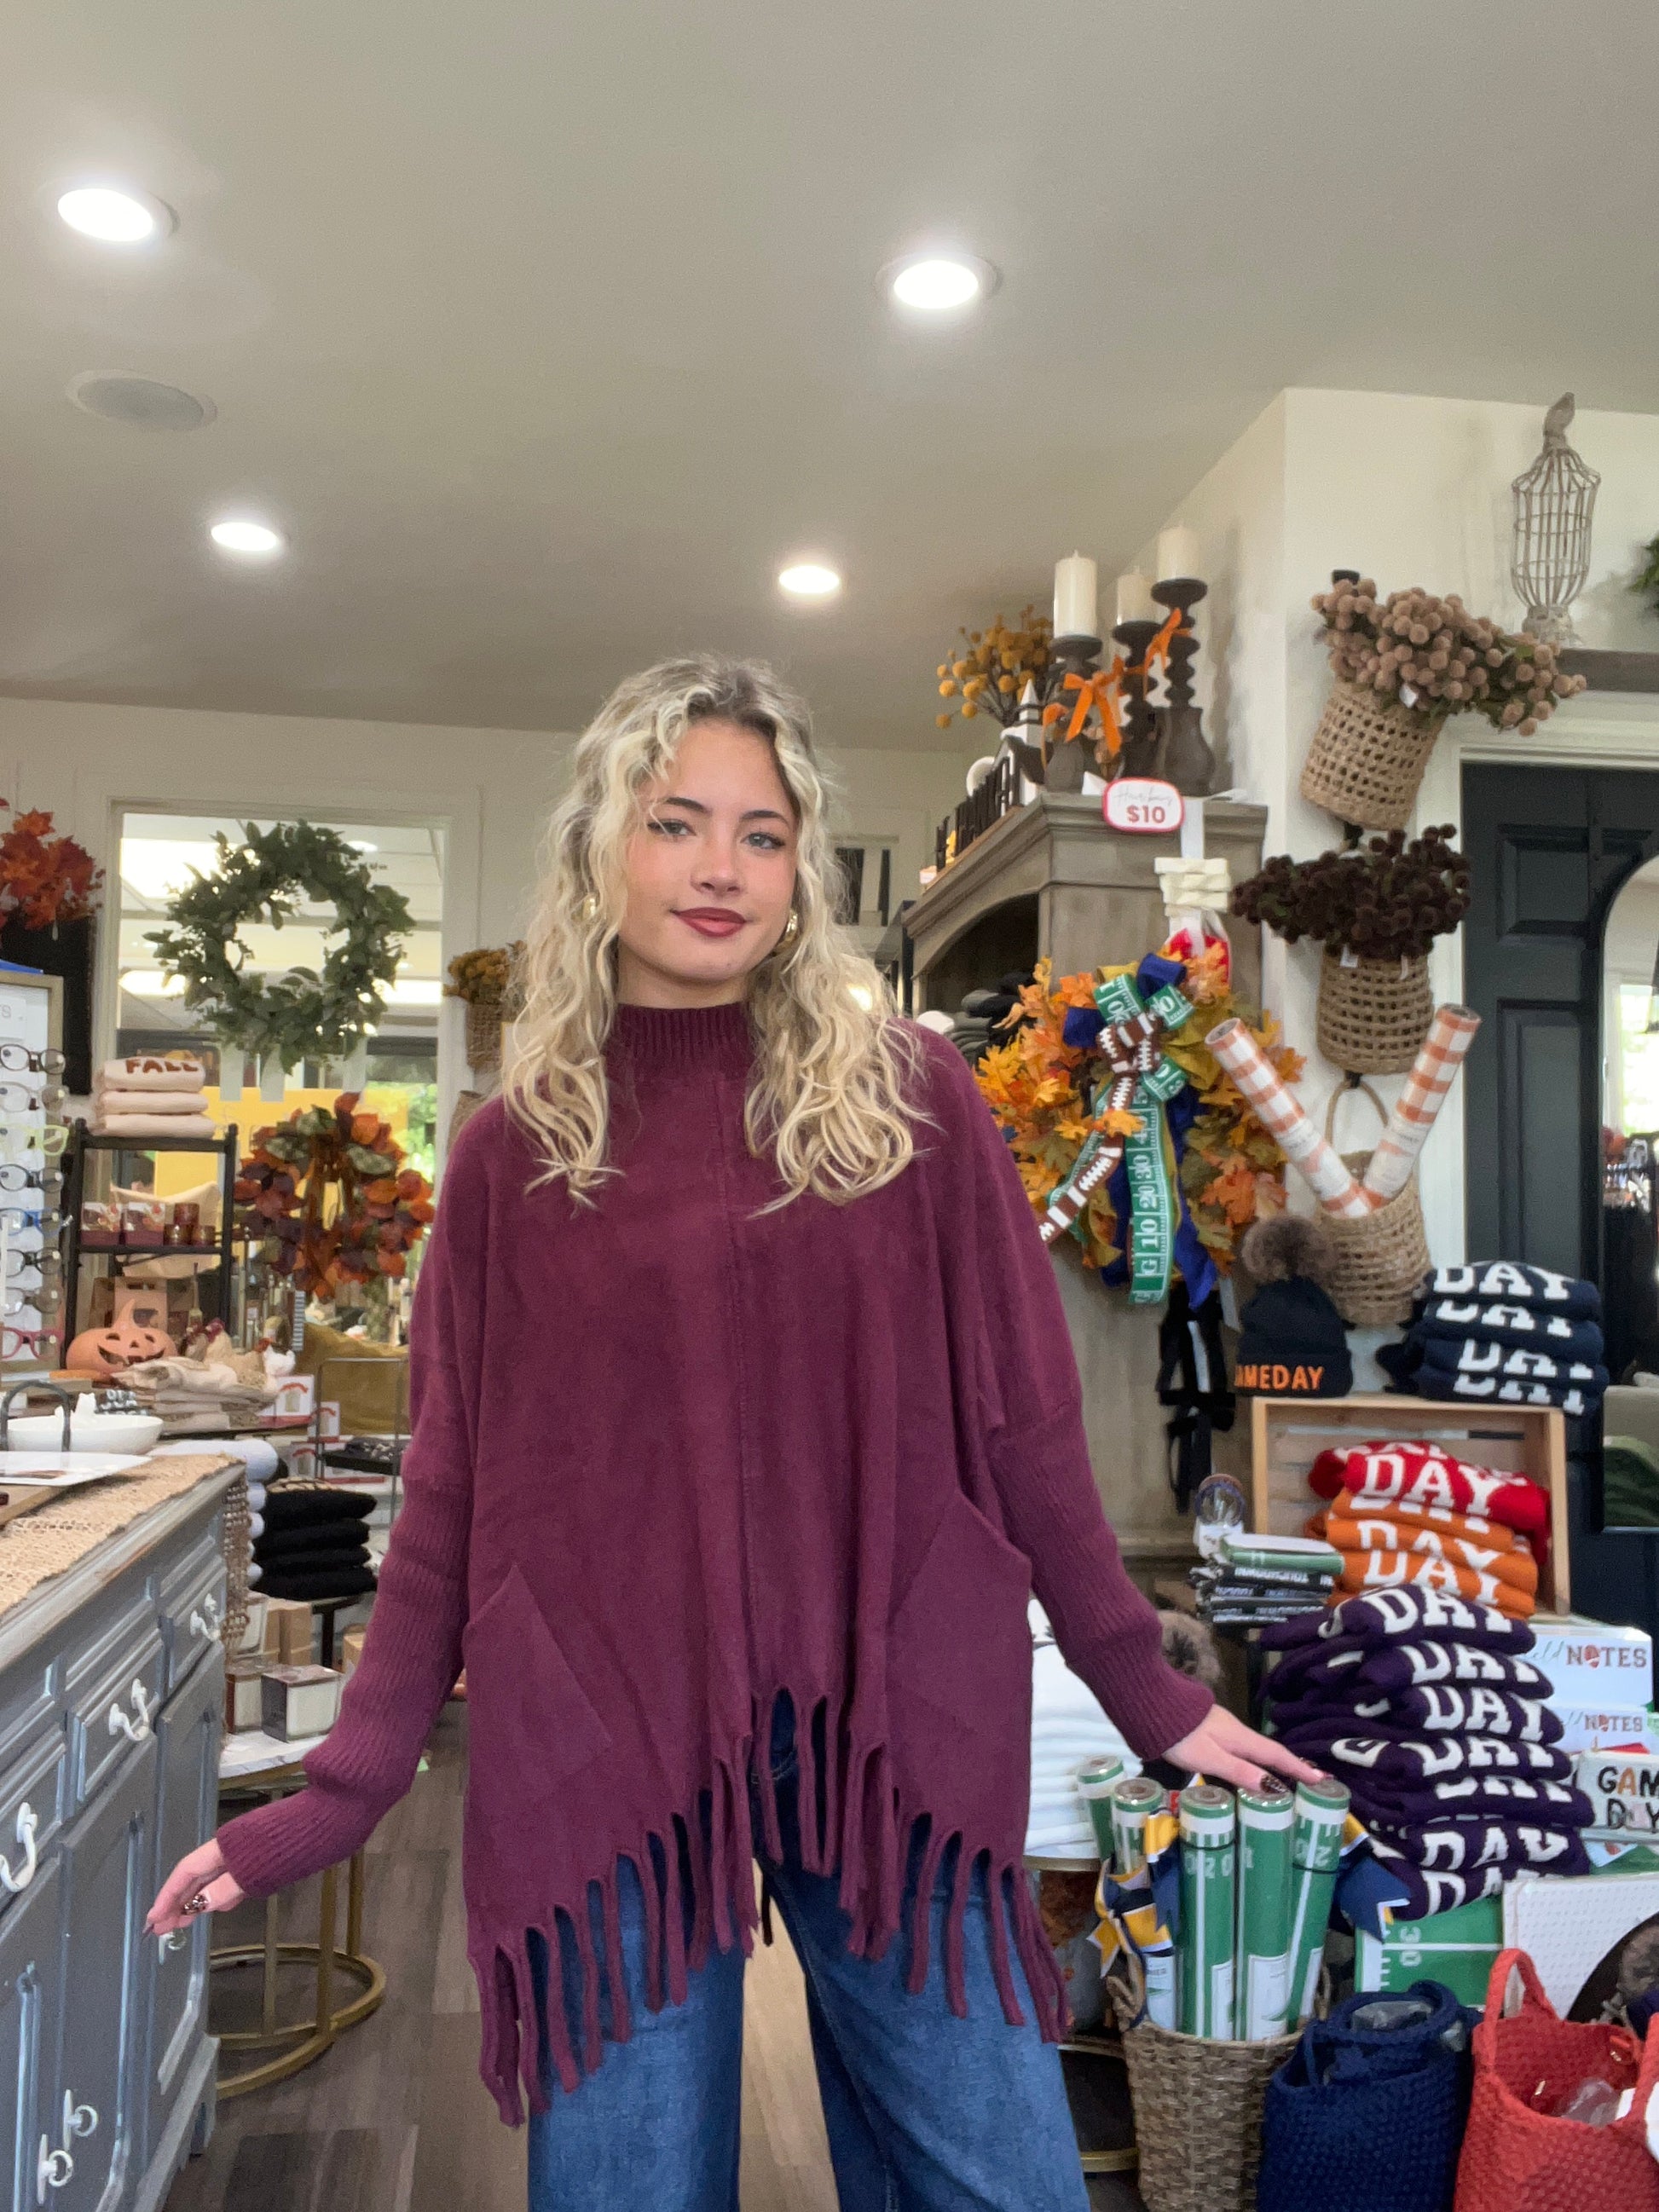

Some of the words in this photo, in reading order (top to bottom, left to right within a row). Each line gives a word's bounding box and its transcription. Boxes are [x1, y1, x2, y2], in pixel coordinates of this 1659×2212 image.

[1126, 805, 1165, 824] $10
[125, 1059, 199, 1074] FALL
[1133, 1155, 1151, 1180] 30
[1138, 1185, 1157, 1209] 20
[1140, 1218, 1159, 1249] 10
[1141, 1259, 1159, 1275] G
[1434, 1262, 1575, 1300] DAY
[1358, 1453, 1506, 1516] DAY
